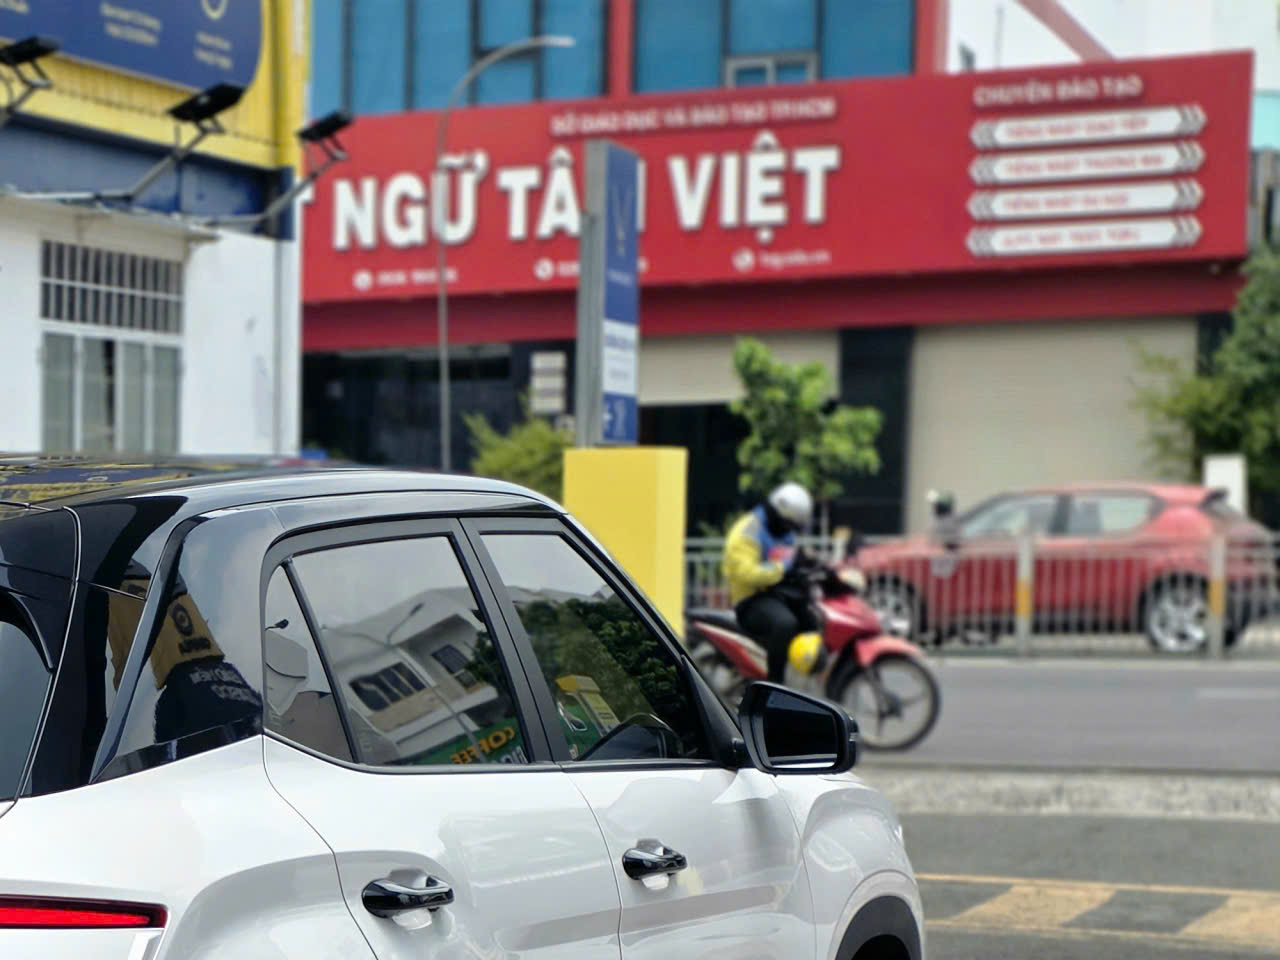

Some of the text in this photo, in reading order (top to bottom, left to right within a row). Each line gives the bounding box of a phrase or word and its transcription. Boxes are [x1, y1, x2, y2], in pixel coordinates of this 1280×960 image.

[333, 130, 840, 250] NGỮ TÂ VIỆT
